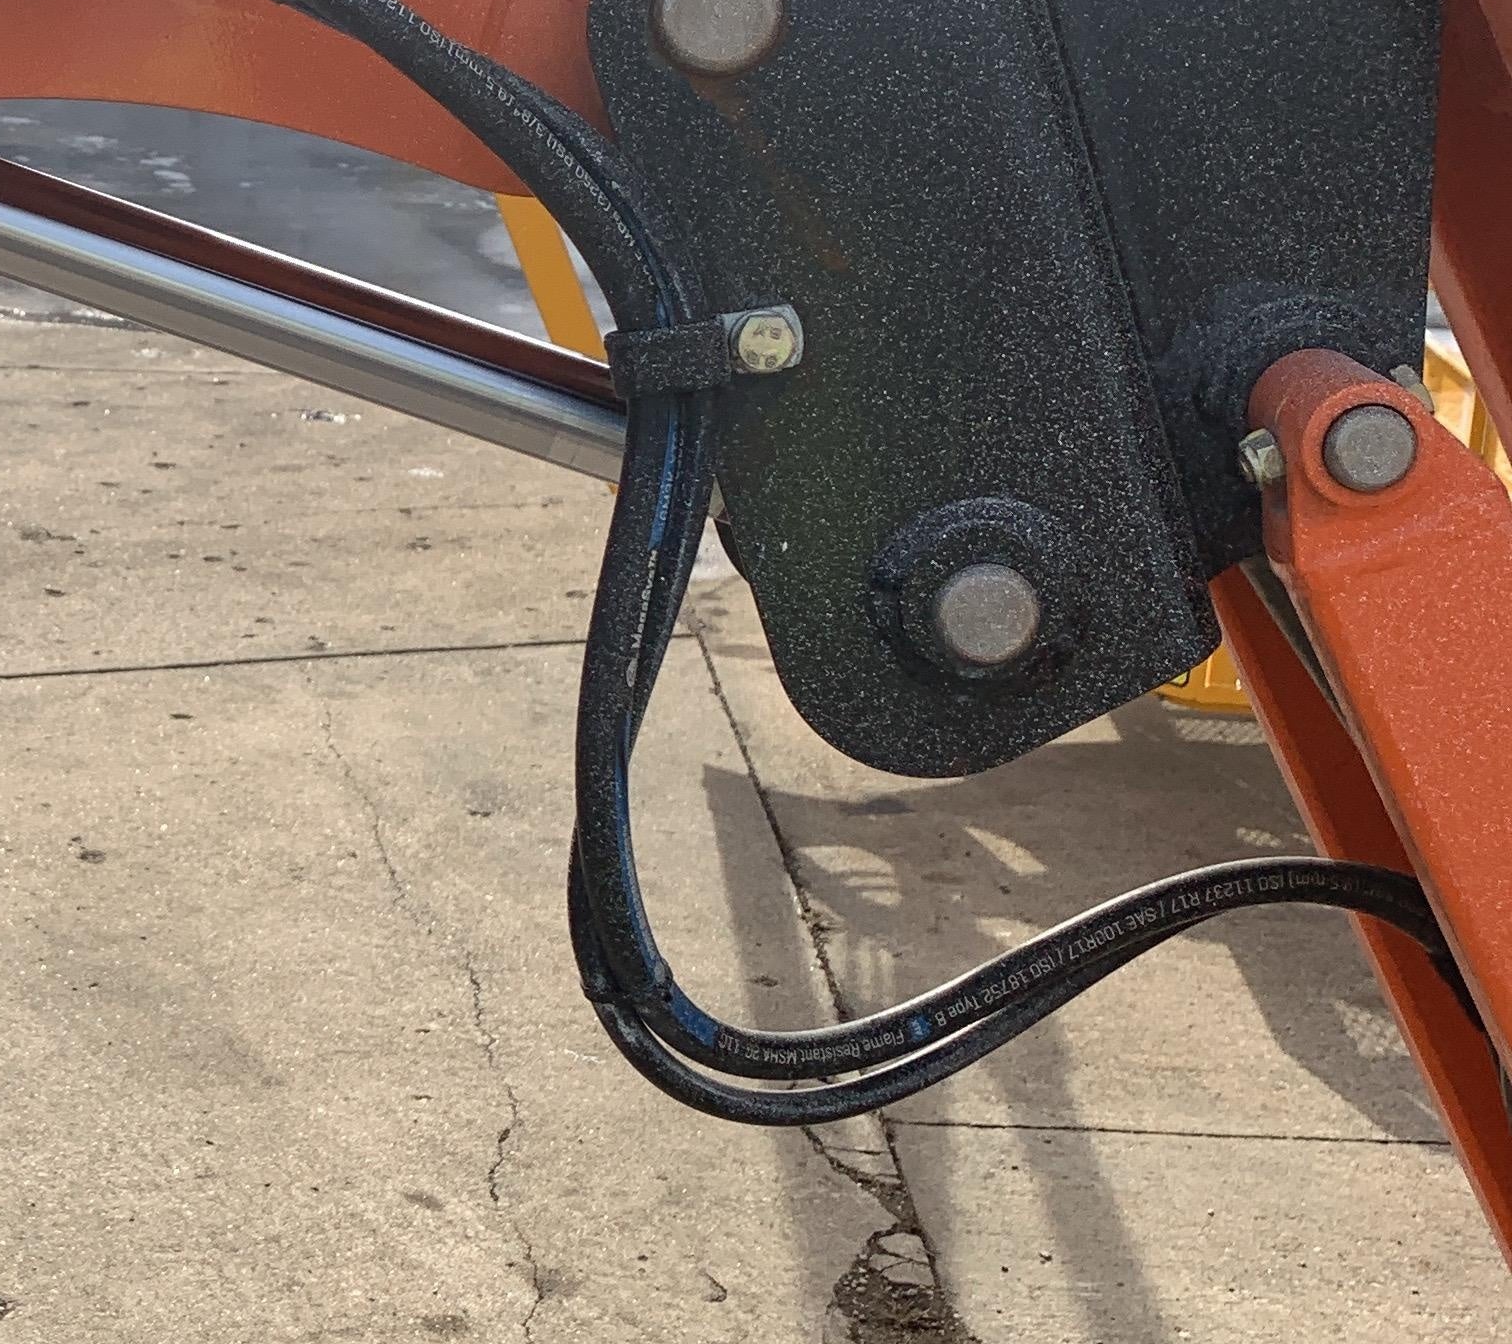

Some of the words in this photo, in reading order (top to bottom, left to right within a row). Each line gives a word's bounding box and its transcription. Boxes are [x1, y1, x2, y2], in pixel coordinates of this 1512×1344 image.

[416, 19, 448, 47] ISO
[1204, 877, 1252, 903] 11237
[1257, 873, 1283, 890] ISO
[1171, 890, 1200, 914] R17
[1126, 906, 1158, 930] SAE
[1068, 920, 1124, 960] 100R17
[1029, 954, 1053, 977] ISO
[983, 969, 1026, 1003] 18752
[947, 991, 981, 1017] Type
[935, 1010, 945, 1026] B
[798, 1037, 860, 1063] Resistant
[862, 1029, 904, 1051] Flame
[761, 1047, 797, 1064] MSHA
